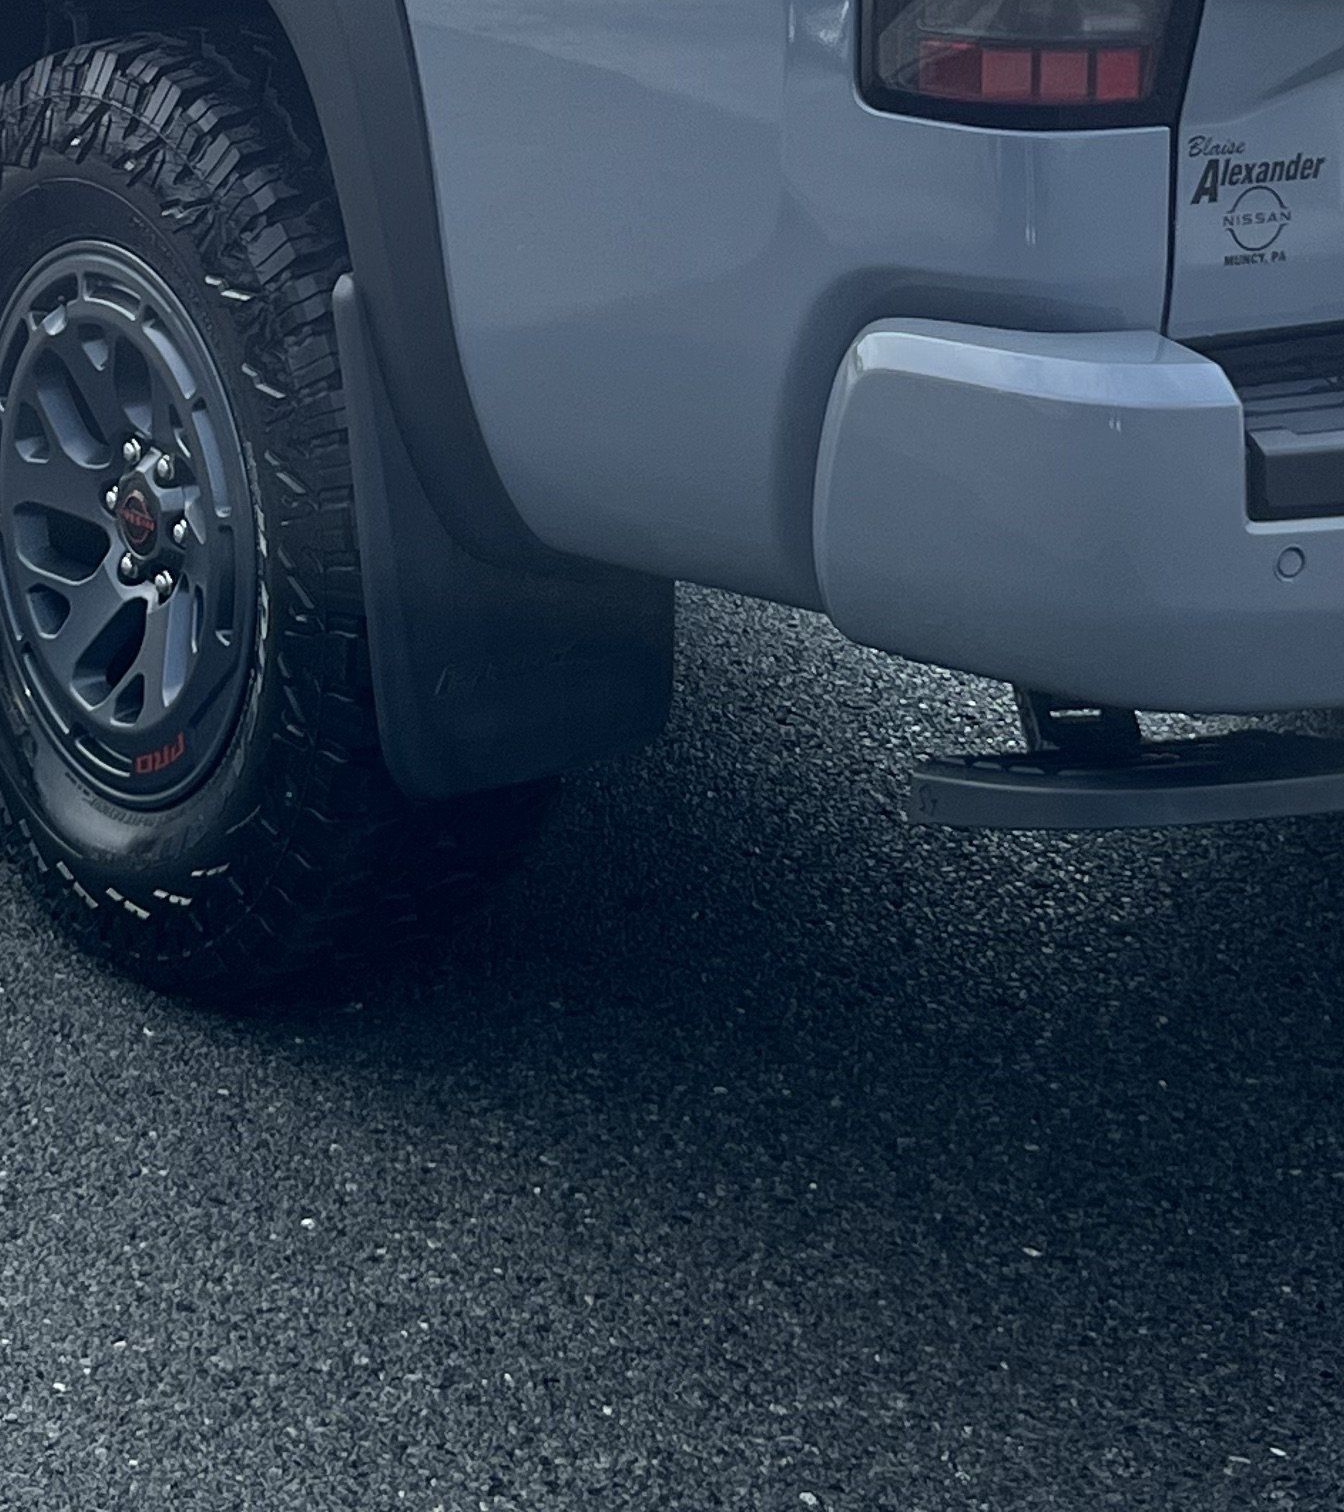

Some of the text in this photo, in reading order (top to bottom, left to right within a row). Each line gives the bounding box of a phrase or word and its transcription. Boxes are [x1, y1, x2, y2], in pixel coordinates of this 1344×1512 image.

[1187, 134, 1246, 158] Blaise
[1190, 152, 1326, 206] Alexander
[1222, 210, 1292, 228] NISSAN
[1271, 250, 1287, 263] PA
